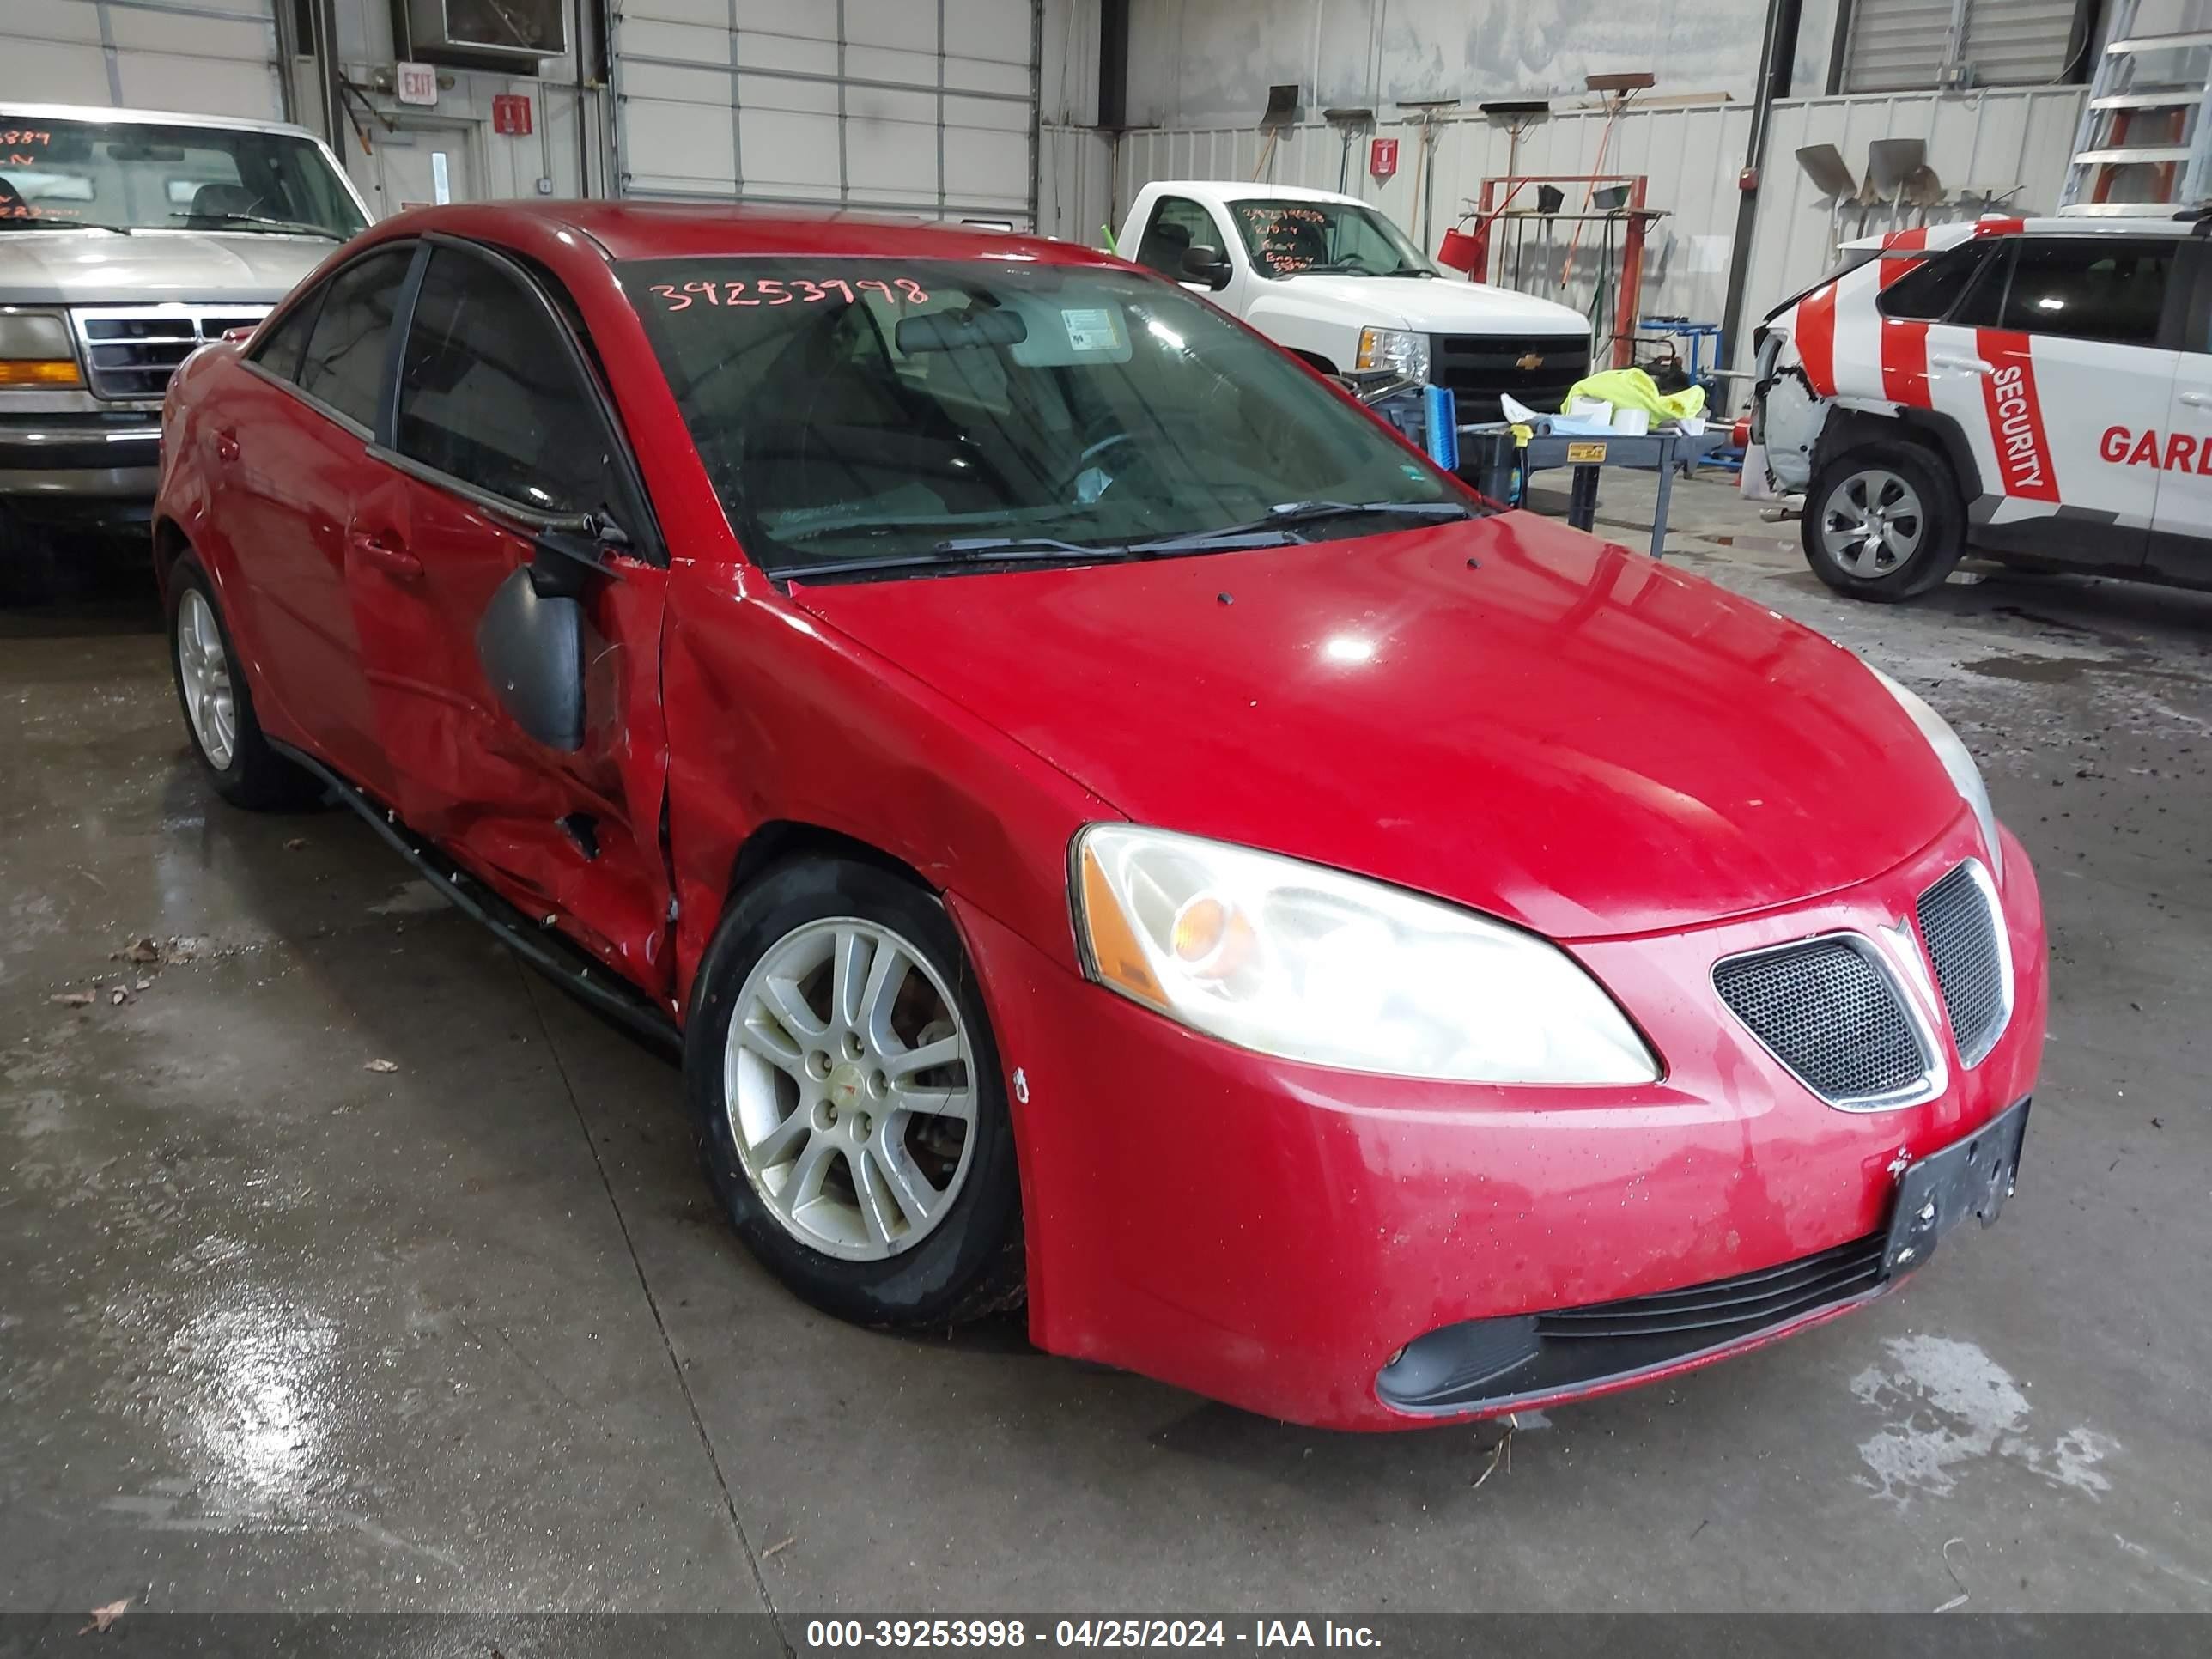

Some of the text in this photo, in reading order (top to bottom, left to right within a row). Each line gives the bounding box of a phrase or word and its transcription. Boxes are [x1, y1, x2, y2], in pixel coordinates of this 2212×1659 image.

[404, 72, 431, 96] EXIT
[649, 278, 929, 310] 39253998
[1992, 365, 2044, 488] SECURITY
